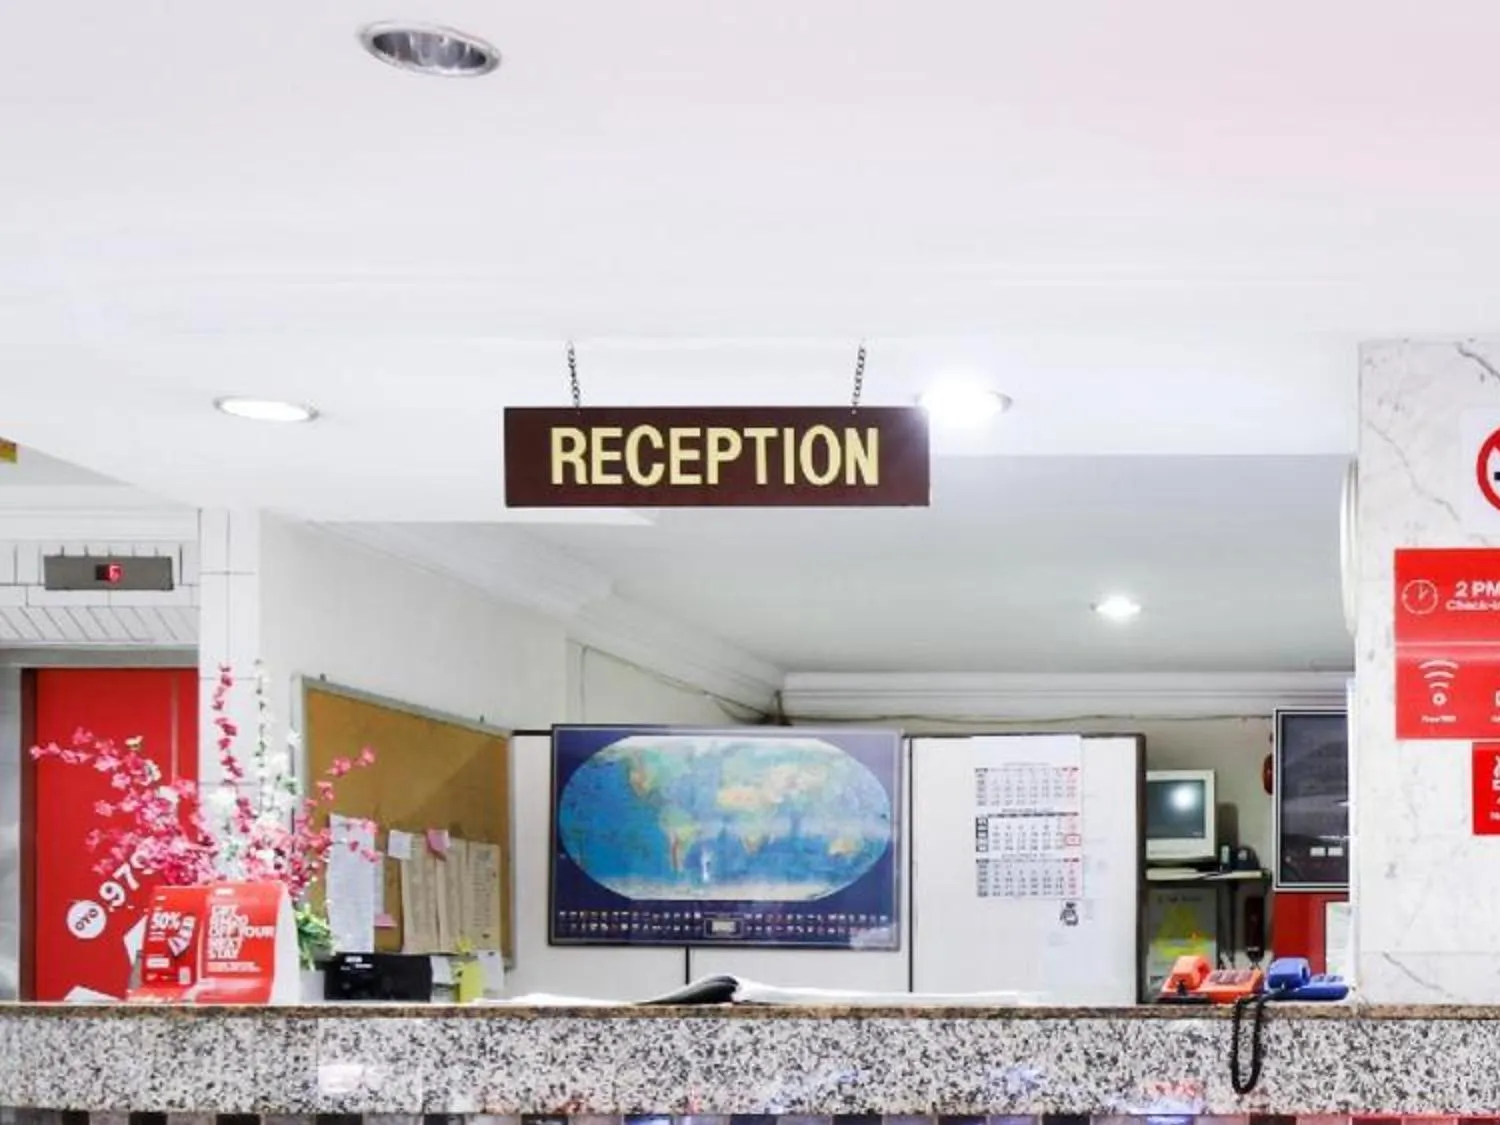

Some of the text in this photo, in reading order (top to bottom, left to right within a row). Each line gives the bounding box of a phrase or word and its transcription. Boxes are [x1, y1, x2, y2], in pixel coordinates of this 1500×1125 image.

[550, 424, 879, 487] RECEPTION
[1455, 580, 1469, 597] 2
[74, 907, 99, 931] OYO
